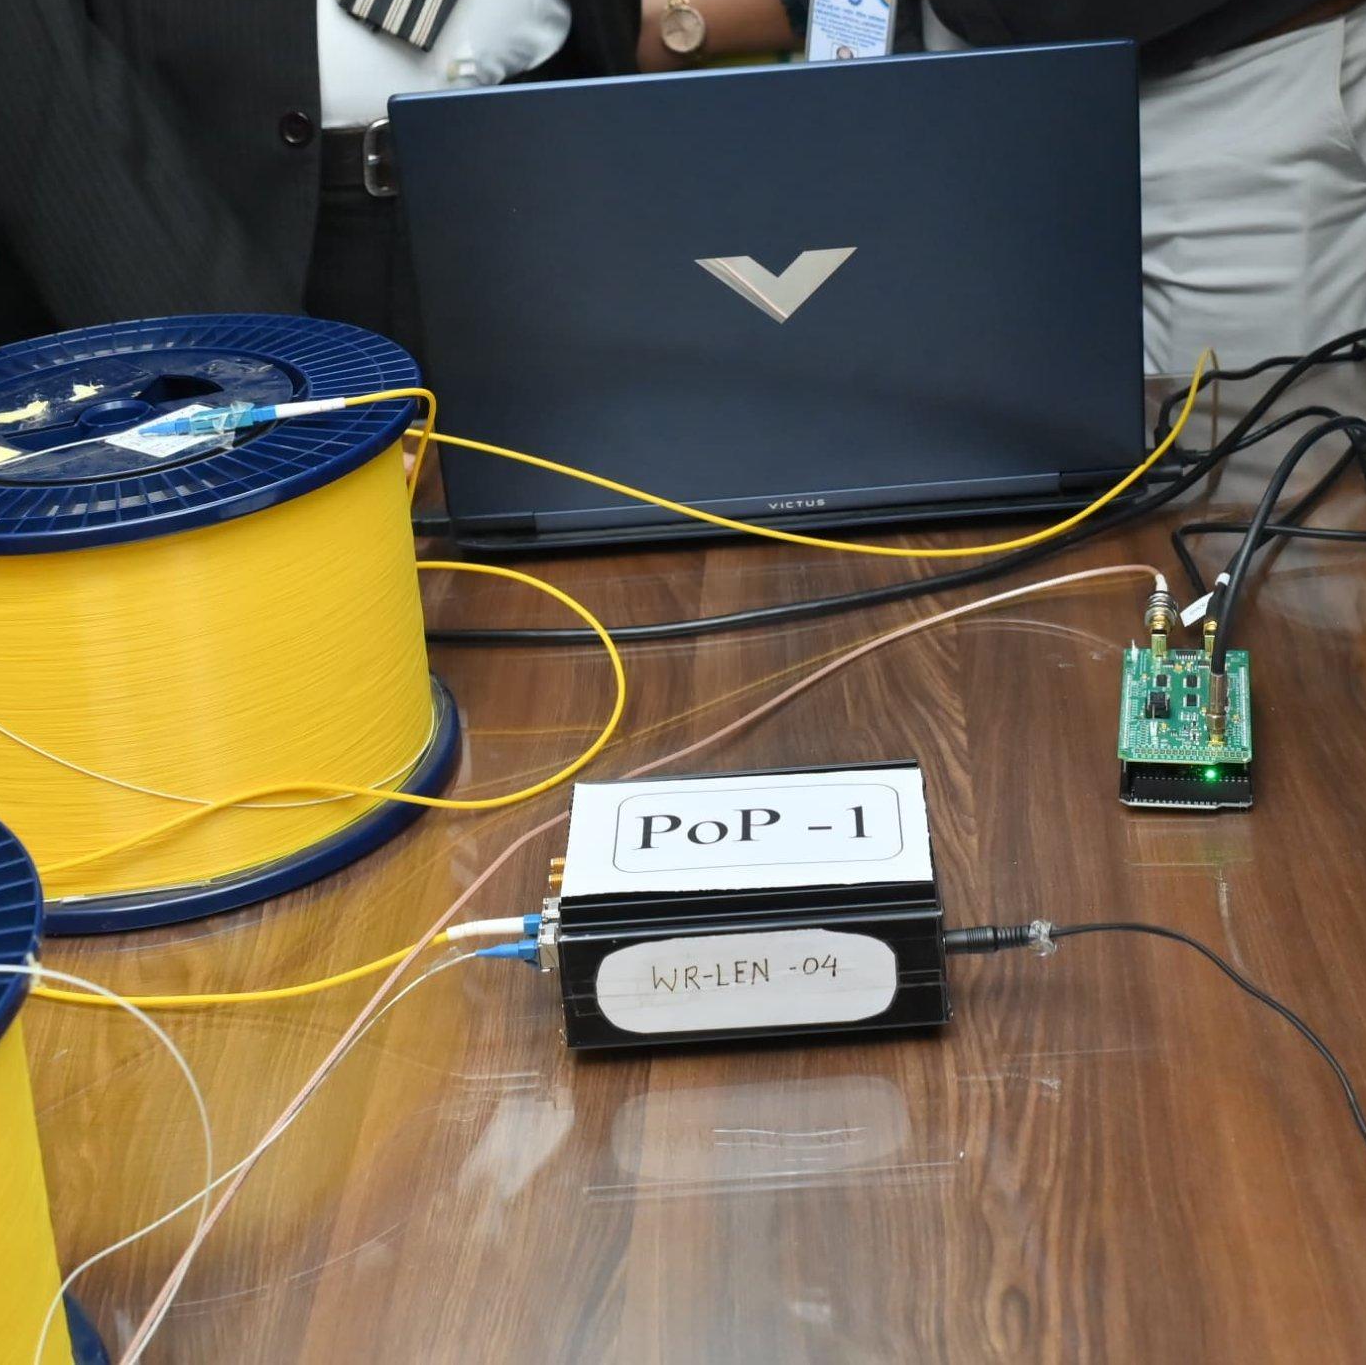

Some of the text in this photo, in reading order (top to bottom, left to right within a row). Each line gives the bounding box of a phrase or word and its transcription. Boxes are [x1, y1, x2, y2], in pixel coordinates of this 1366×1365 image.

[767, 498, 827, 510] VICTUS
[631, 807, 781, 851] PoP
[651, 958, 770, 993] WR-LEN
